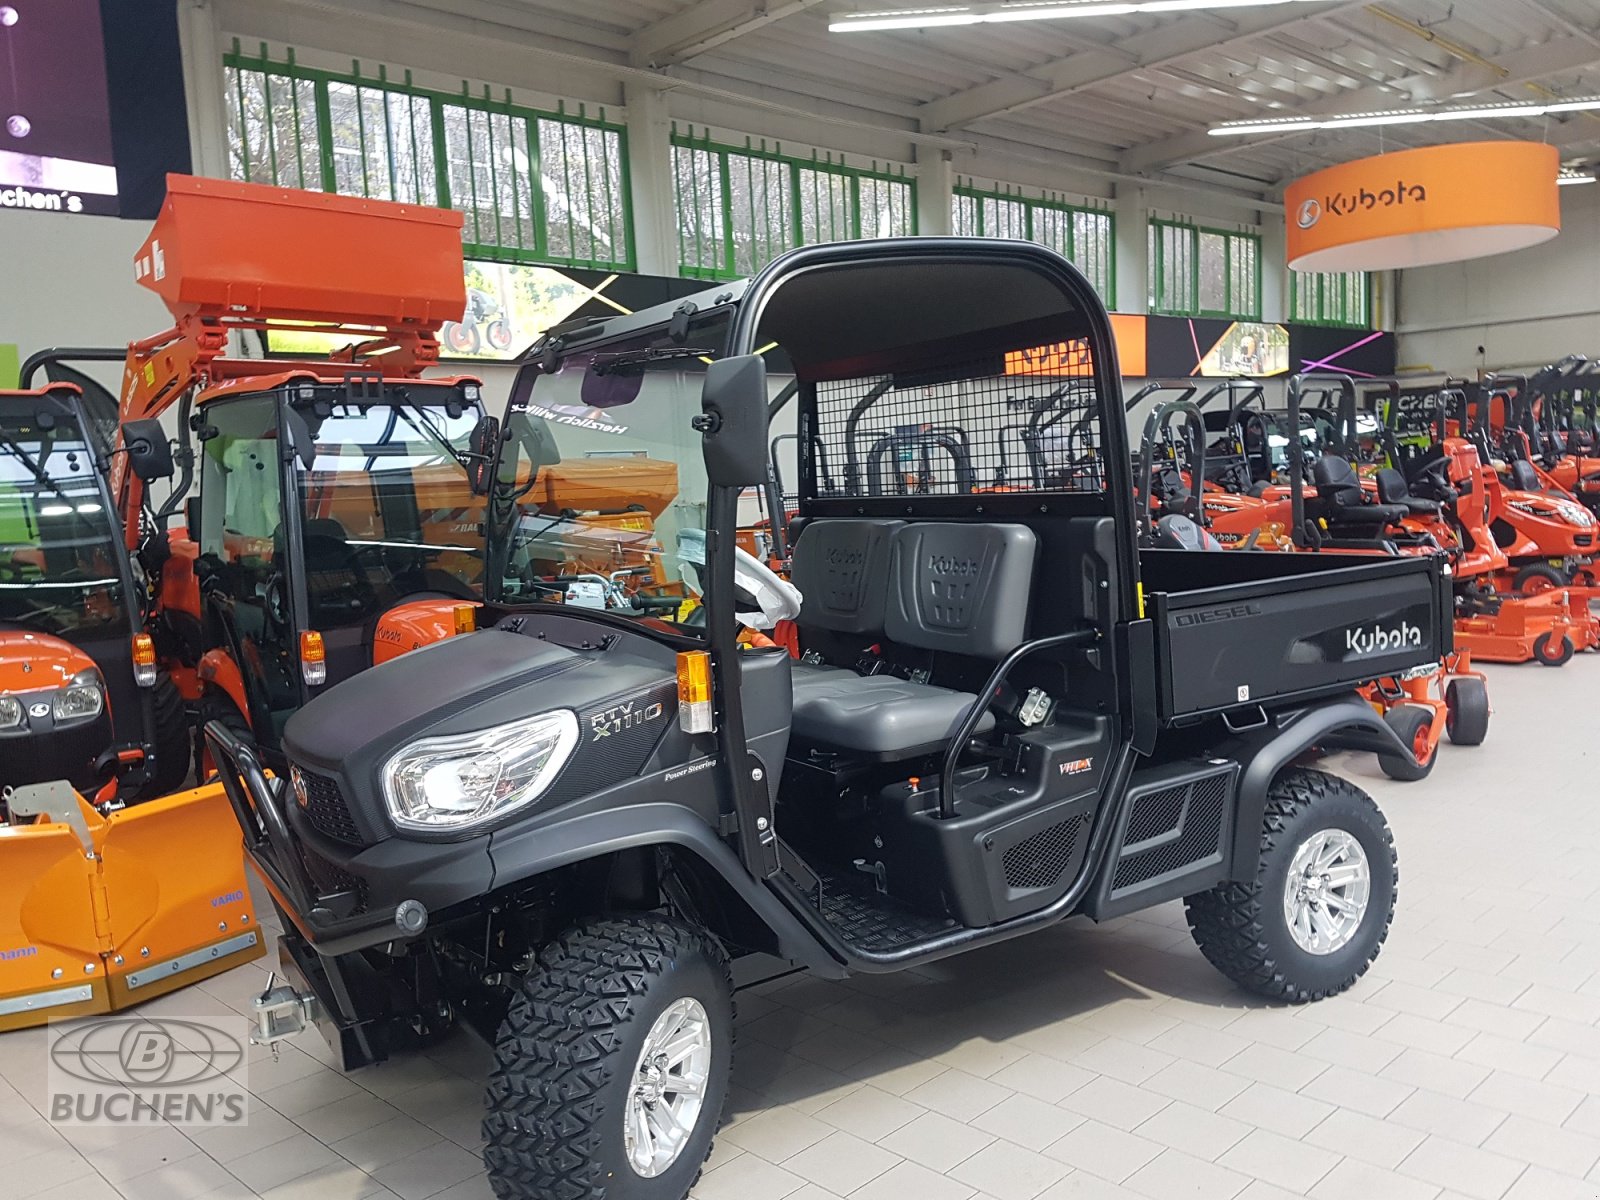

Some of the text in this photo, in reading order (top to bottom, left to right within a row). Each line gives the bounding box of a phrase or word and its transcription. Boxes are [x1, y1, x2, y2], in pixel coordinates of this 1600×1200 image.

[1325, 180, 1426, 216] Kubota
[1176, 605, 1263, 628] DIESEL
[1346, 621, 1421, 654] Kubota
[591, 701, 634, 727] RTV
[592, 702, 663, 742] X1110
[664, 759, 717, 782] Power Steering
[211, 890, 244, 907] VARIO
